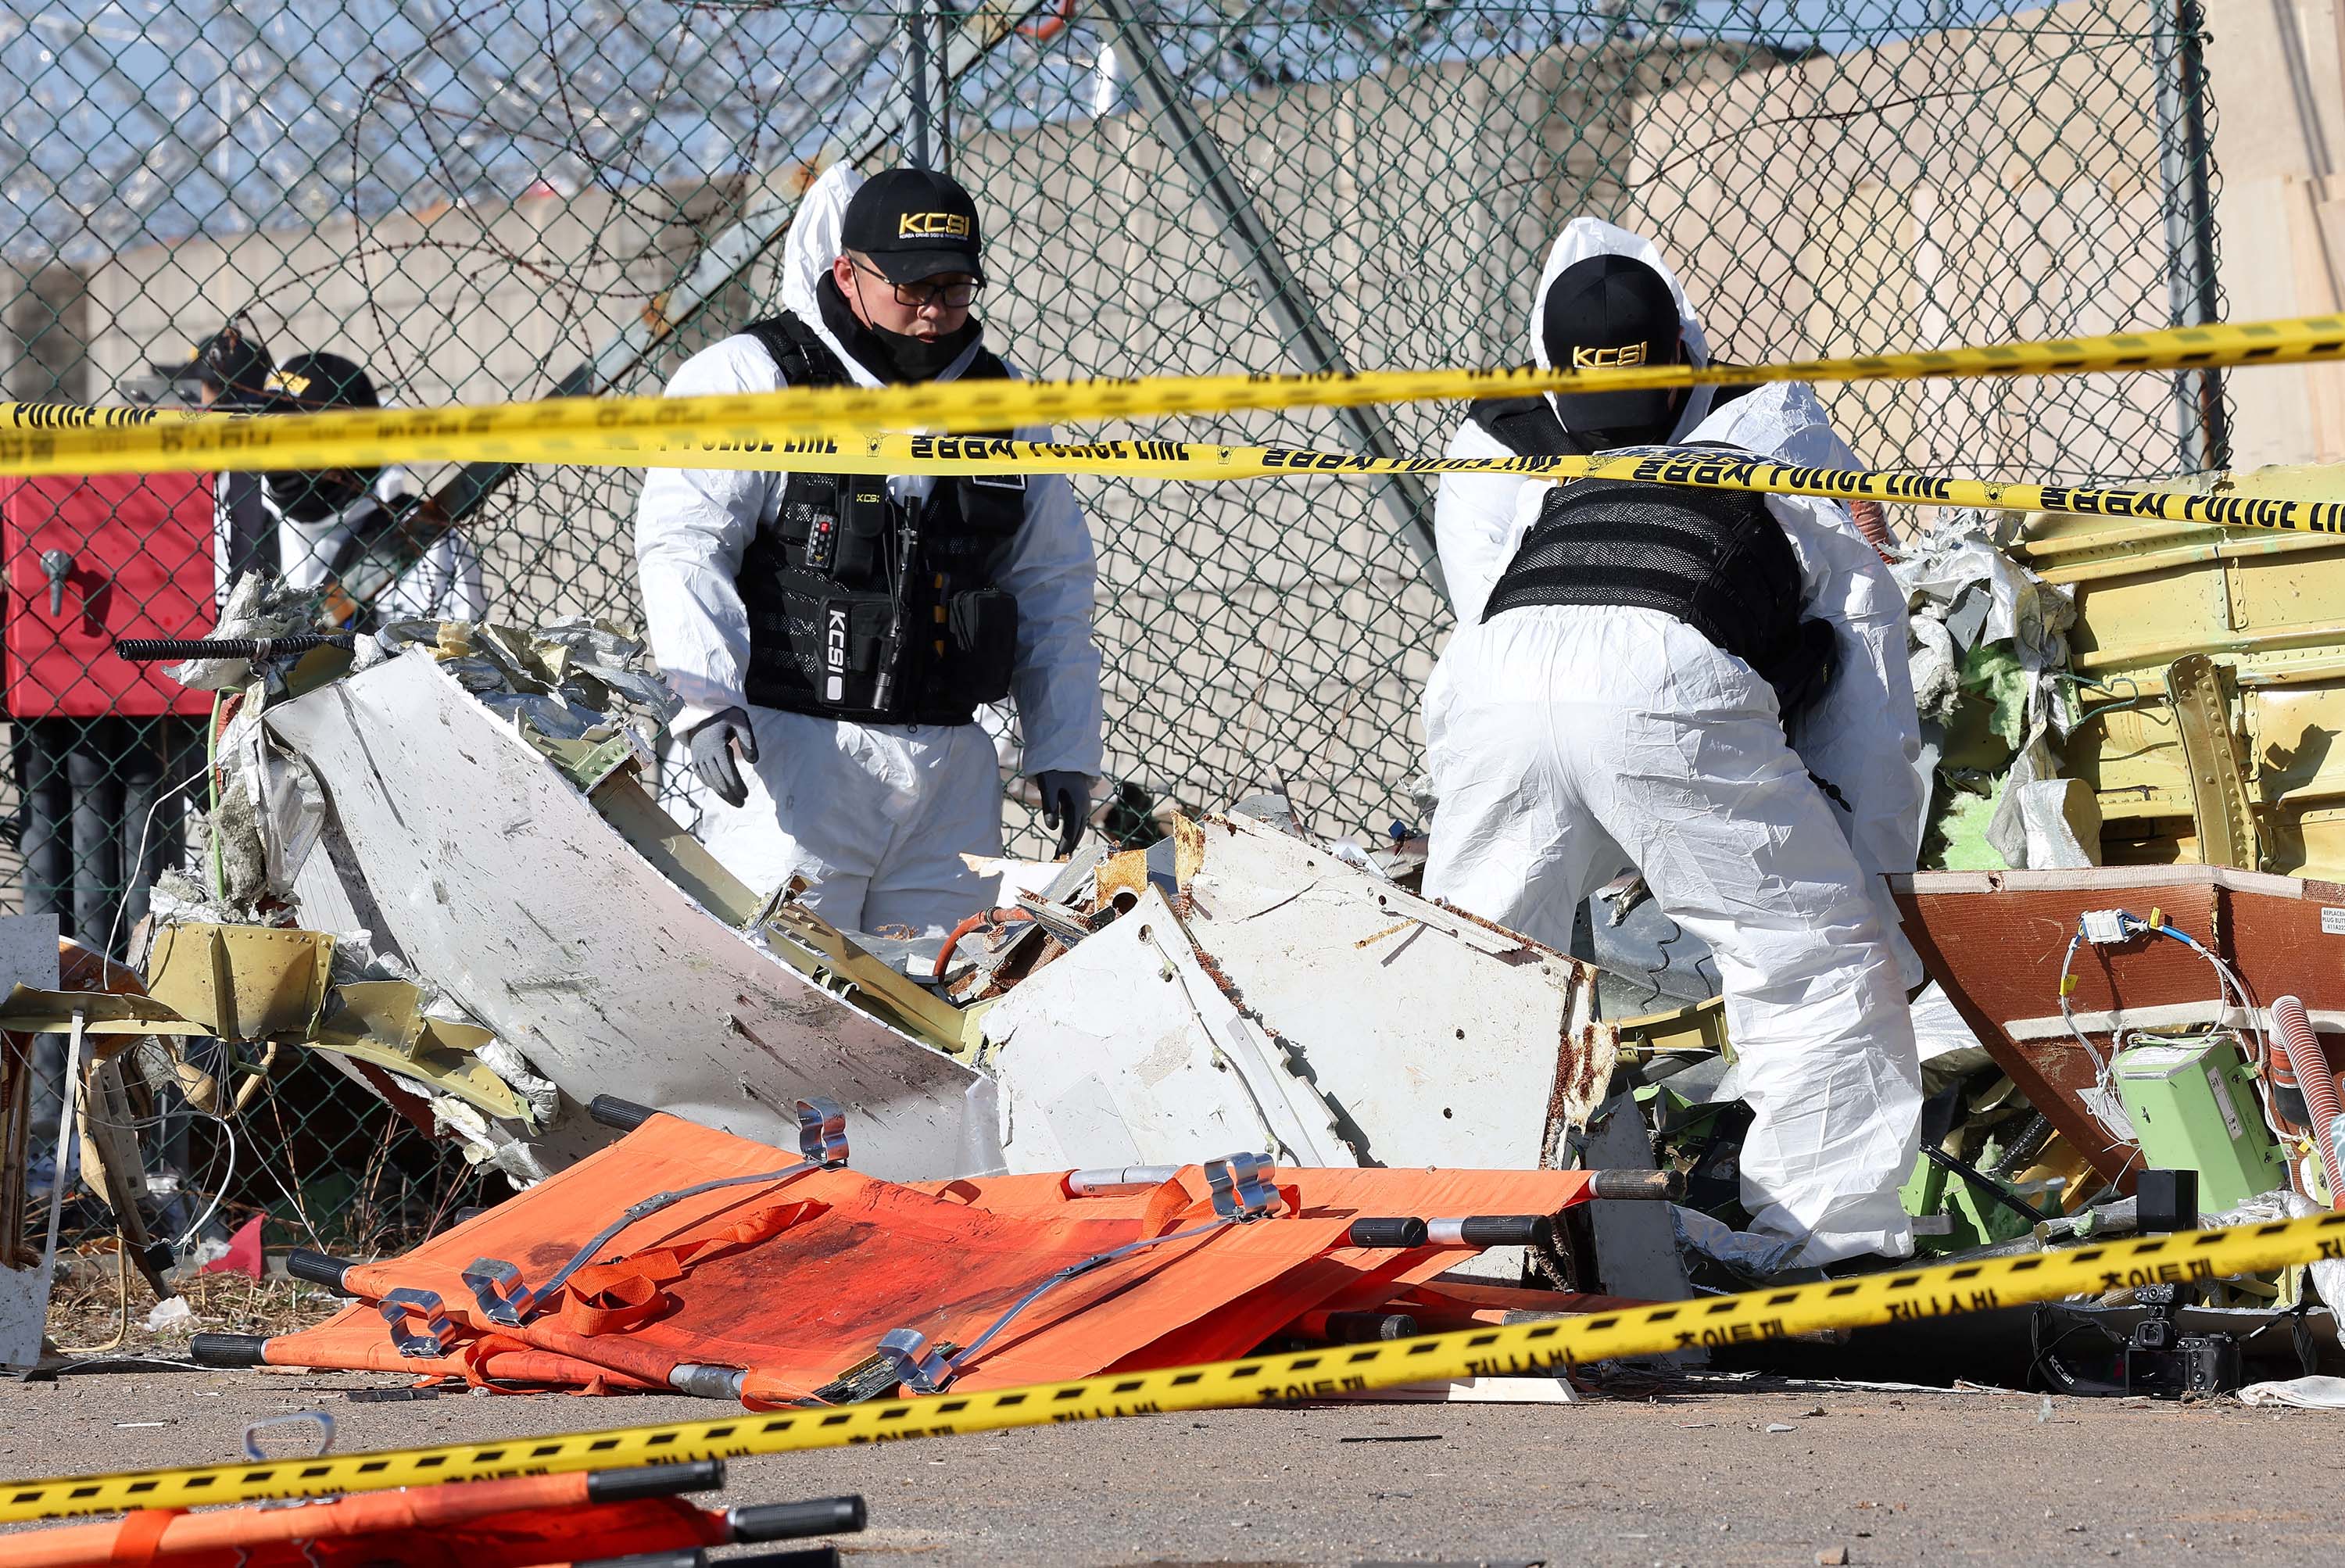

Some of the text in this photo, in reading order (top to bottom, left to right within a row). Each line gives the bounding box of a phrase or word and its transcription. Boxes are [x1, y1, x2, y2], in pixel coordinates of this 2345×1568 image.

[899, 213, 970, 236] KCSI
[1573, 341, 1648, 367] KCSI
[828, 610, 846, 673] KCSI
